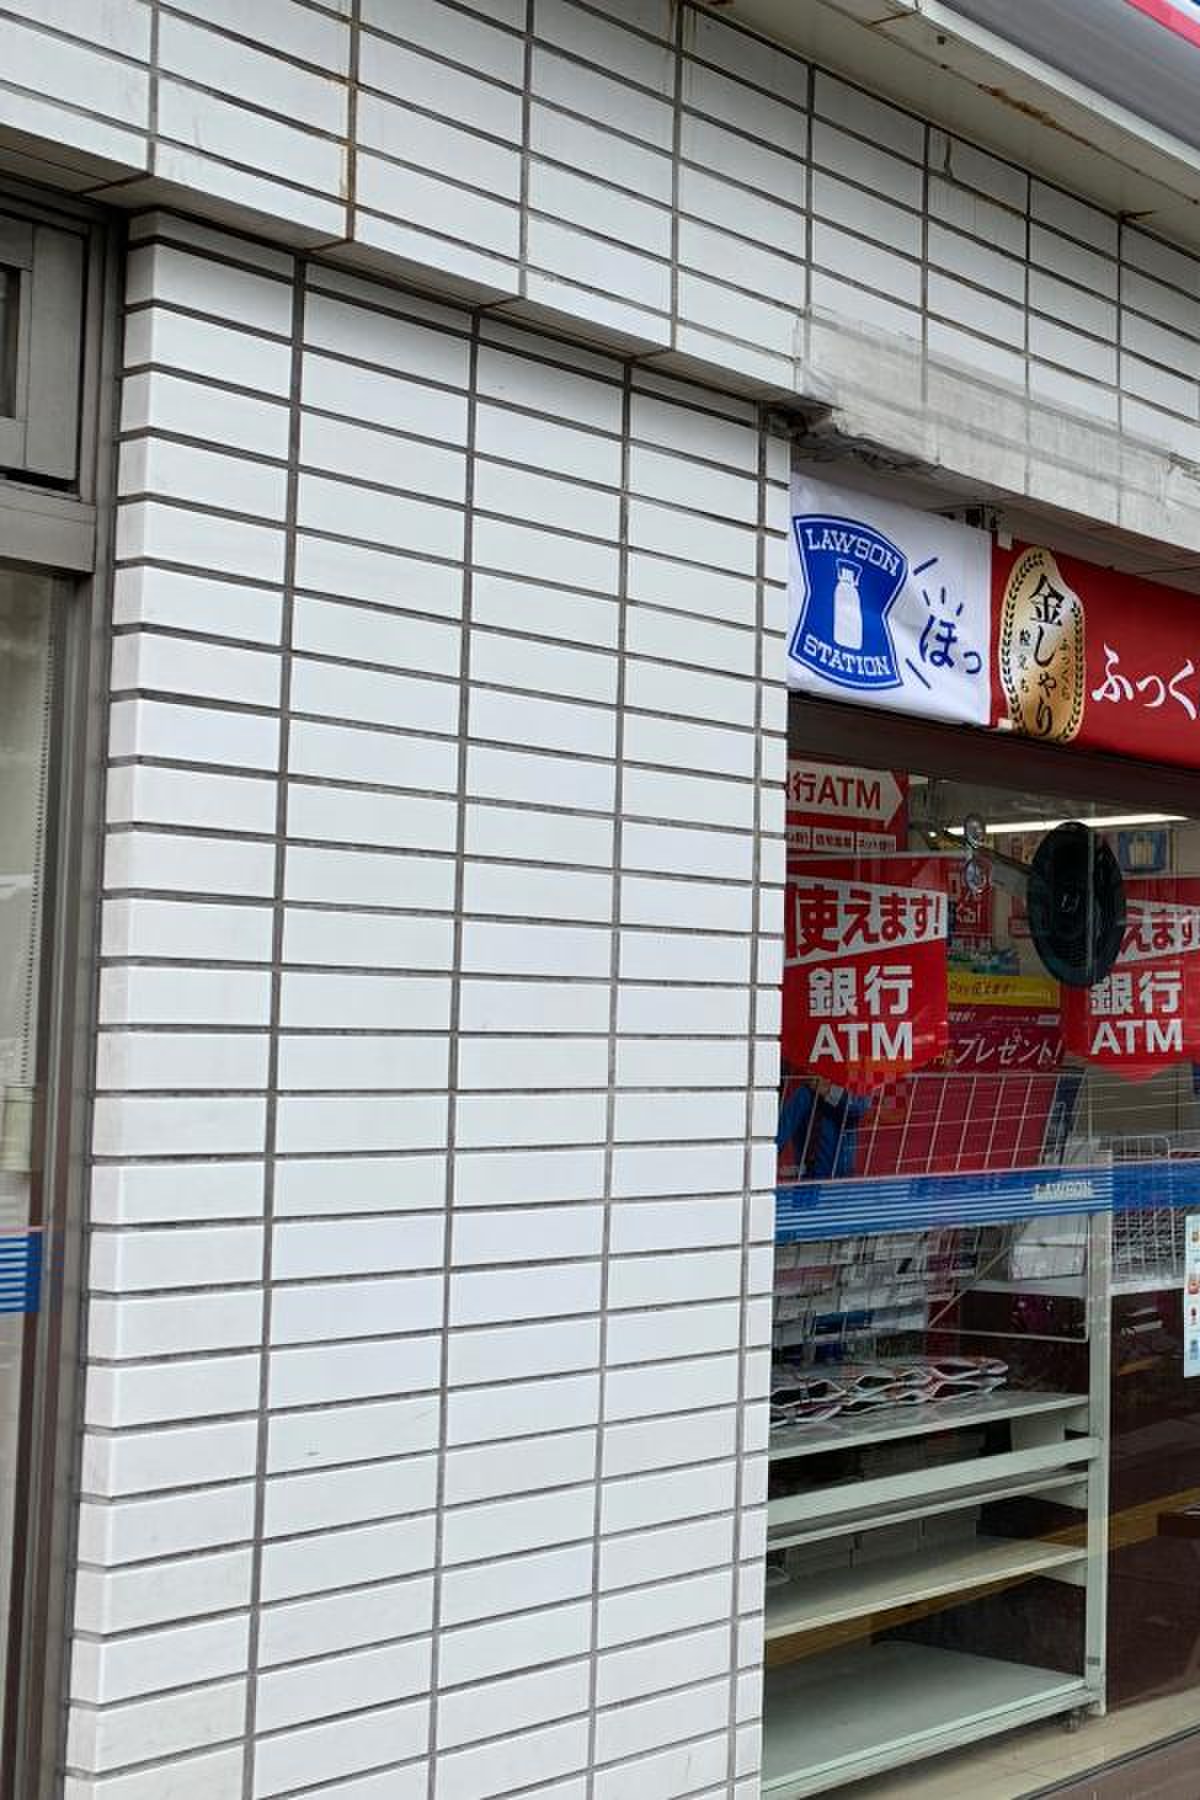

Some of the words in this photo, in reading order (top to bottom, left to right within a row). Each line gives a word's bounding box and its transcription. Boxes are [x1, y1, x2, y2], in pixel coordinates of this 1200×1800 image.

[804, 528, 900, 577] LAWSON
[803, 633, 892, 677] STATION
[920, 614, 982, 675] ほっ
[808, 965, 913, 1018] 銀行
[1090, 970, 1184, 1016] 銀行
[808, 1022, 913, 1064] ATM
[1090, 1019, 1184, 1056] ATM
